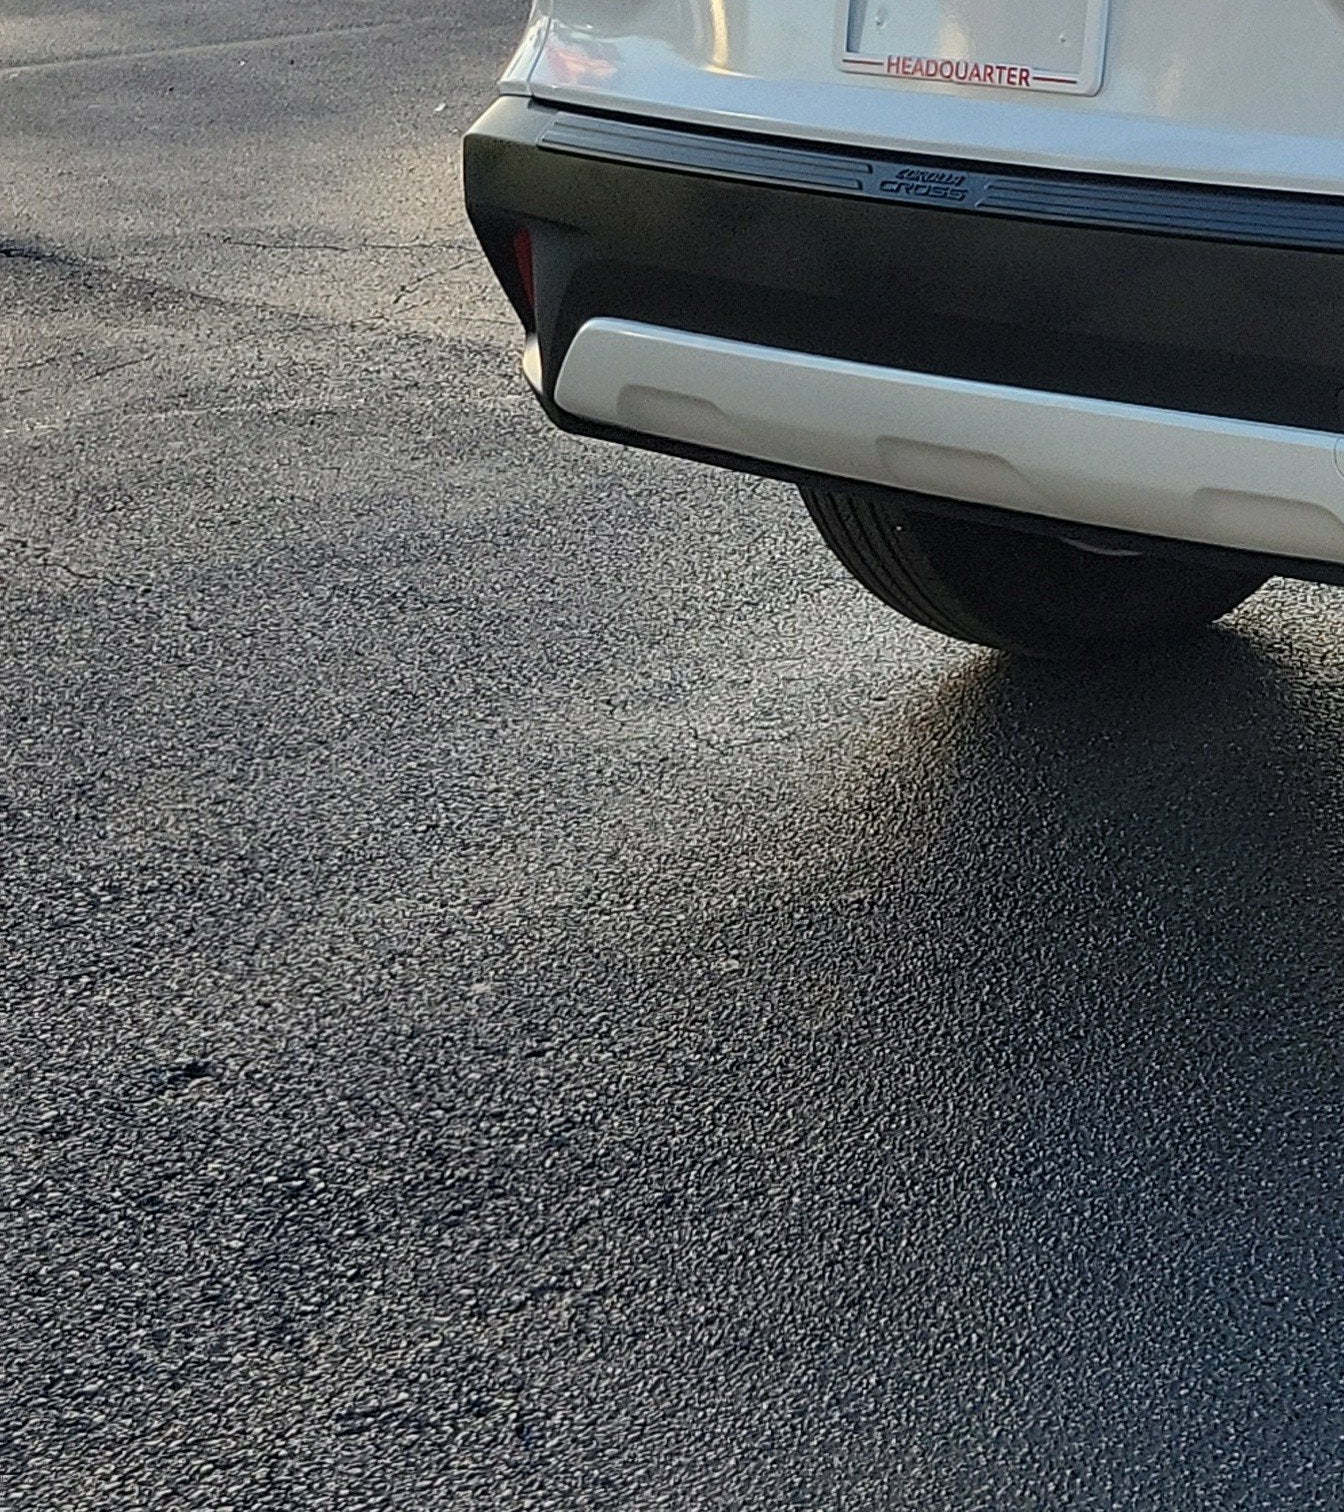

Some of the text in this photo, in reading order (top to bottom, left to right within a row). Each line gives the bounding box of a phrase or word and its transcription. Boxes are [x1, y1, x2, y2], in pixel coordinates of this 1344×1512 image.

[886, 54, 1032, 87] HEADQUARTER
[895, 168, 966, 187] COROLLA
[880, 180, 968, 202] CROSS
